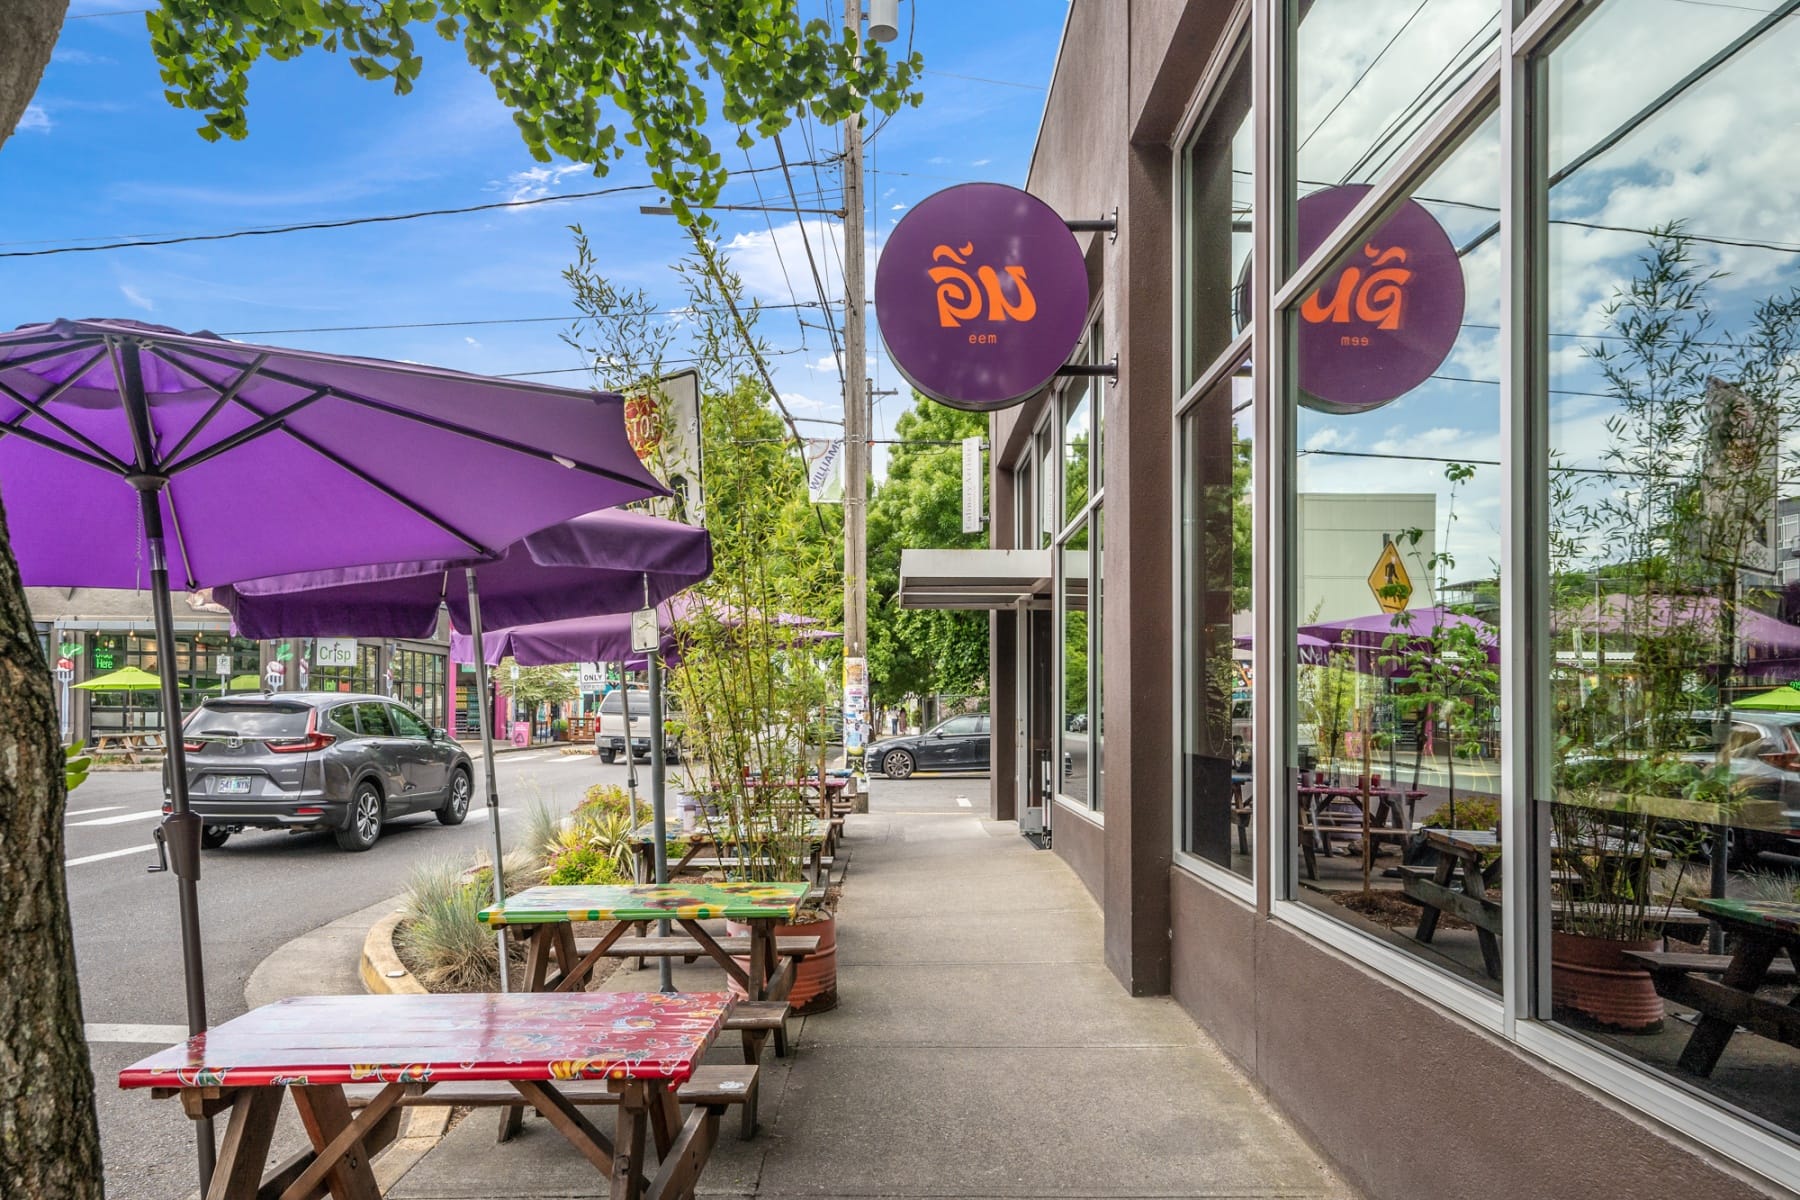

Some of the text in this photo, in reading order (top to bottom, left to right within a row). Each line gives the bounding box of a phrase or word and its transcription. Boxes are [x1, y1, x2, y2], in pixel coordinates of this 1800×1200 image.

[968, 333, 998, 344] eem
[626, 413, 660, 442] TOP
[809, 439, 844, 490] WILLIAMS
[96, 658, 113, 669] Here
[319, 642, 352, 664] Crisp
